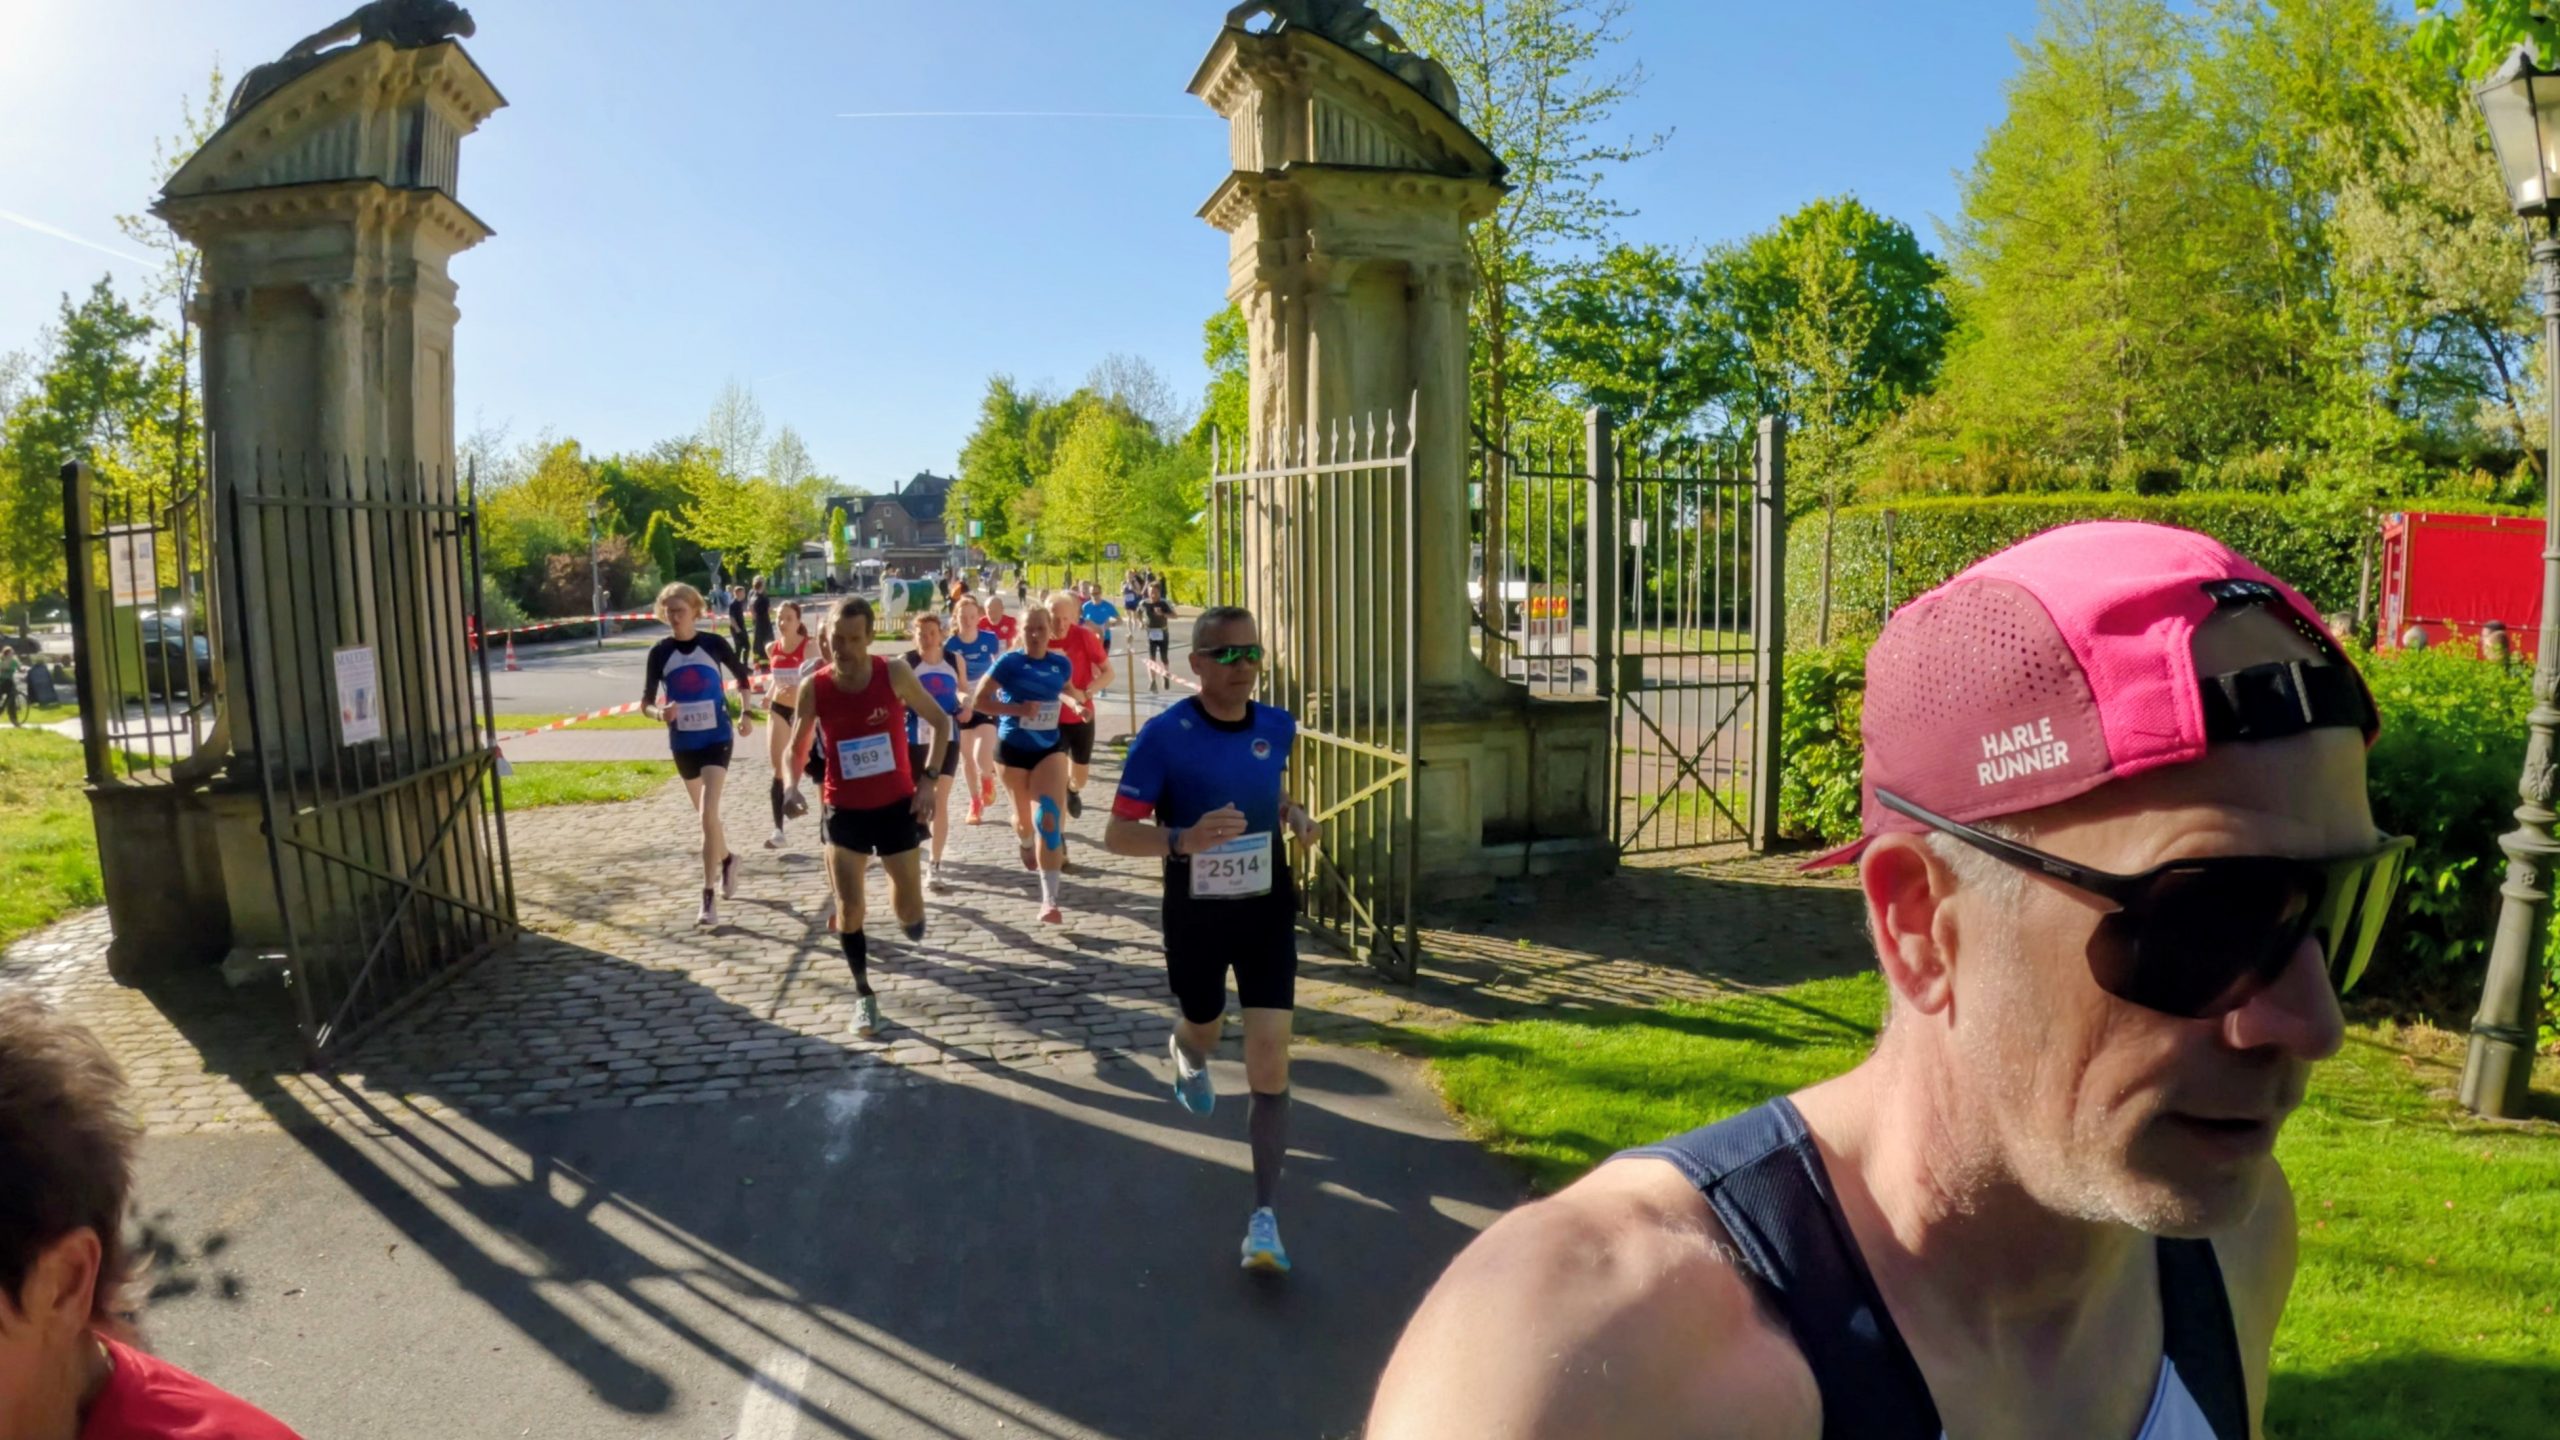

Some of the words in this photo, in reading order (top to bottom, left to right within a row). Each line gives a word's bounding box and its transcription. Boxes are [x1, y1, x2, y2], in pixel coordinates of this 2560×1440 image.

[1981, 716, 2054, 759] HARLE
[851, 749, 879, 766] 969
[1976, 740, 2071, 787] RUNNER
[1207, 854, 1260, 878] 2514
